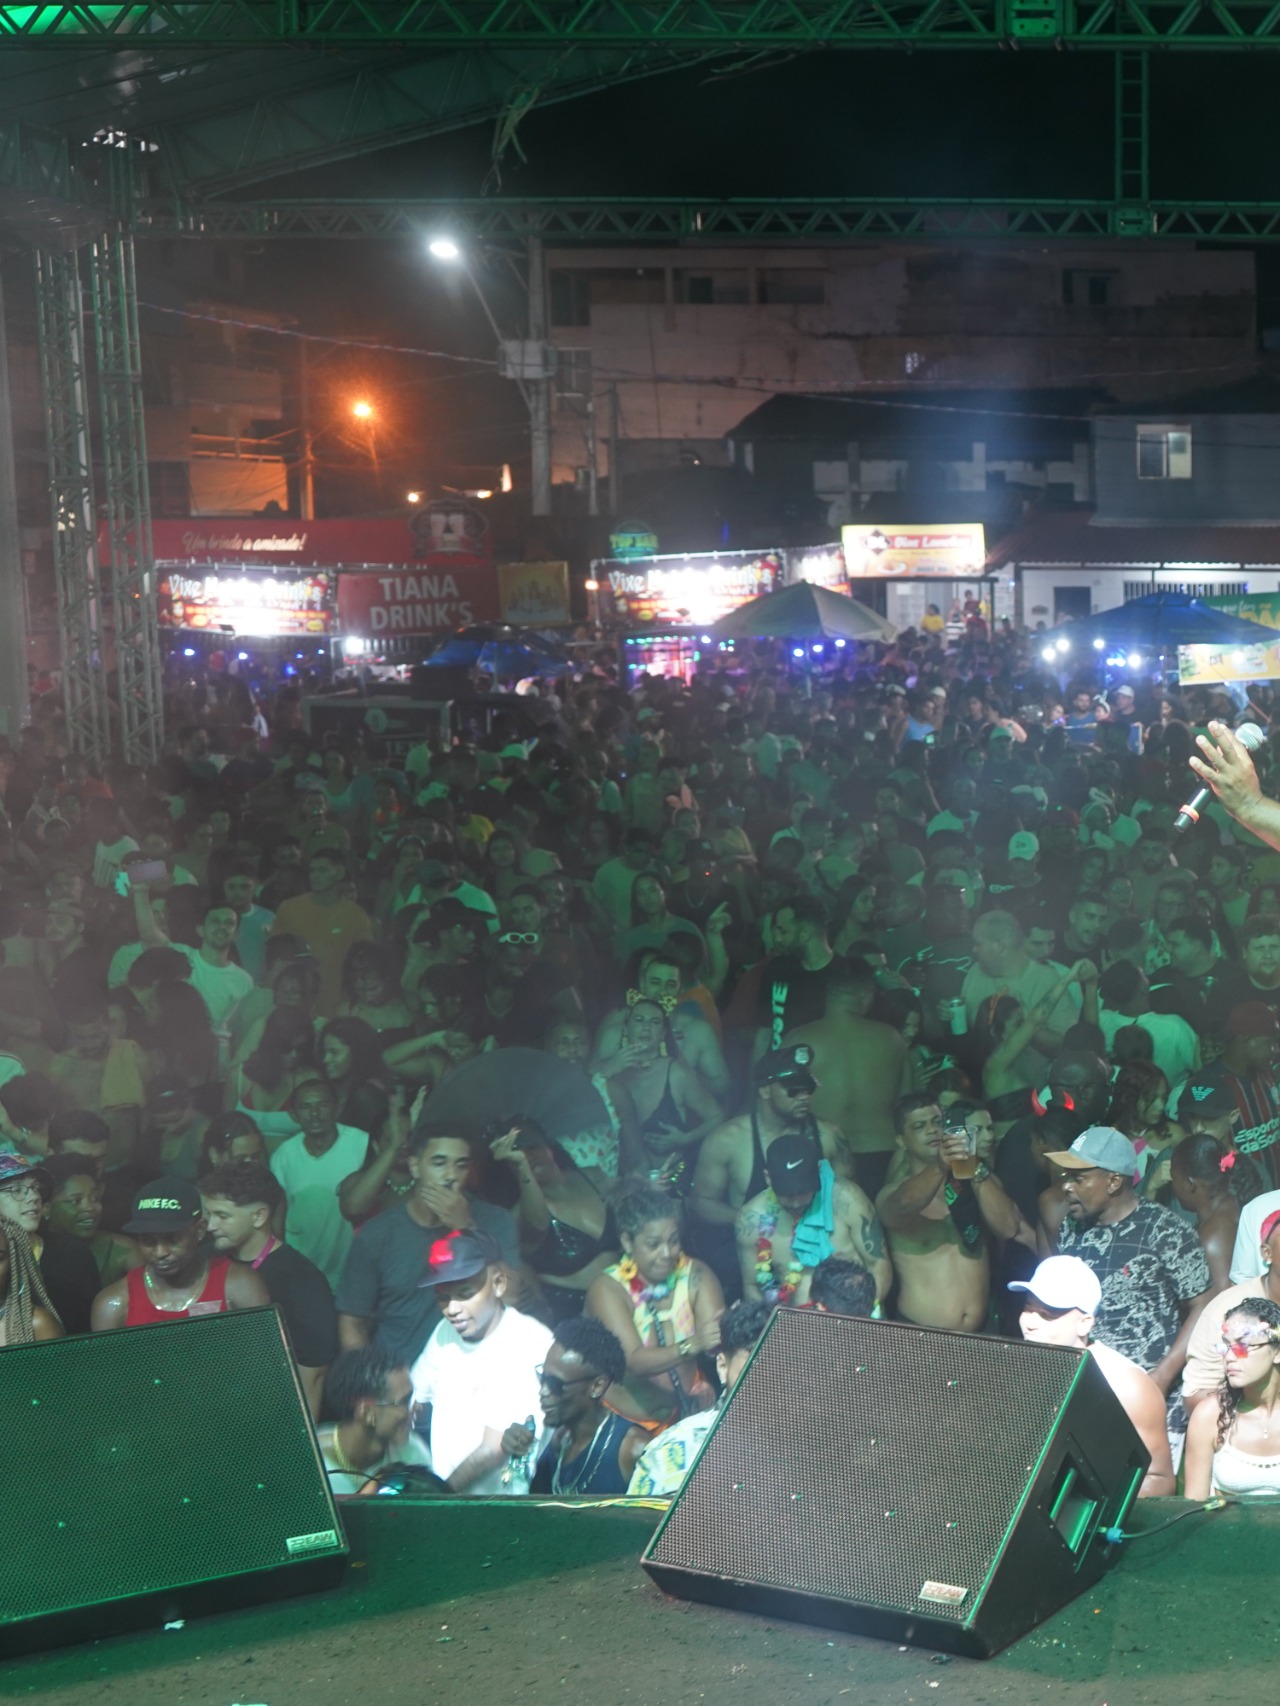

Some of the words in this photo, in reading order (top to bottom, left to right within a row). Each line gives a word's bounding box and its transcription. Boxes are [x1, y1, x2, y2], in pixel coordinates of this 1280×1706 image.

[169, 574, 202, 598] Vixe
[379, 574, 459, 601] TIANA
[608, 570, 645, 593] Vixe
[370, 601, 473, 630] DRINK'S
[138, 1198, 161, 1210] NIKE
[160, 1198, 182, 1210] F.C.
